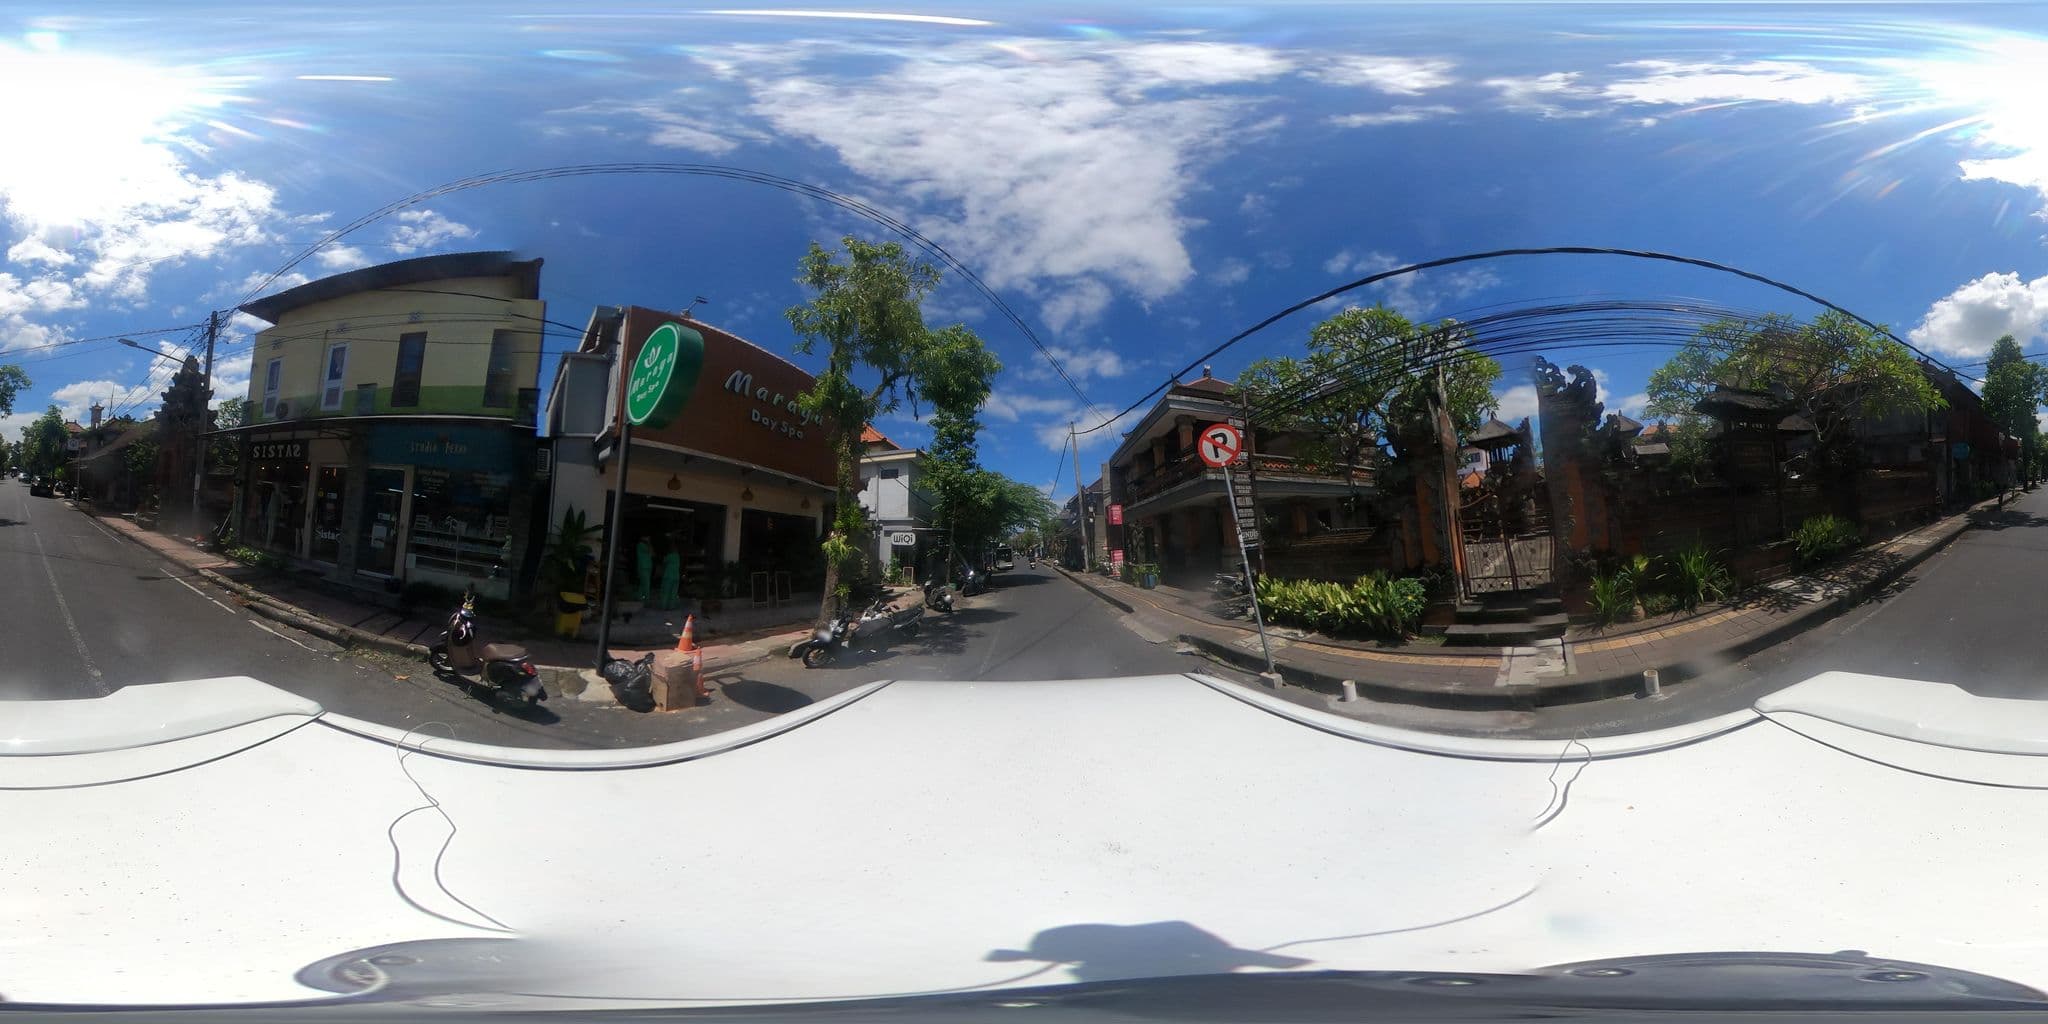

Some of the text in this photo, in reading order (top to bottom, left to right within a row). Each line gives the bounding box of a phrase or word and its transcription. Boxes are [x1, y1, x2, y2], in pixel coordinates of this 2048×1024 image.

[752, 408, 804, 439] Day Spa
[253, 444, 301, 458] SISTAS
